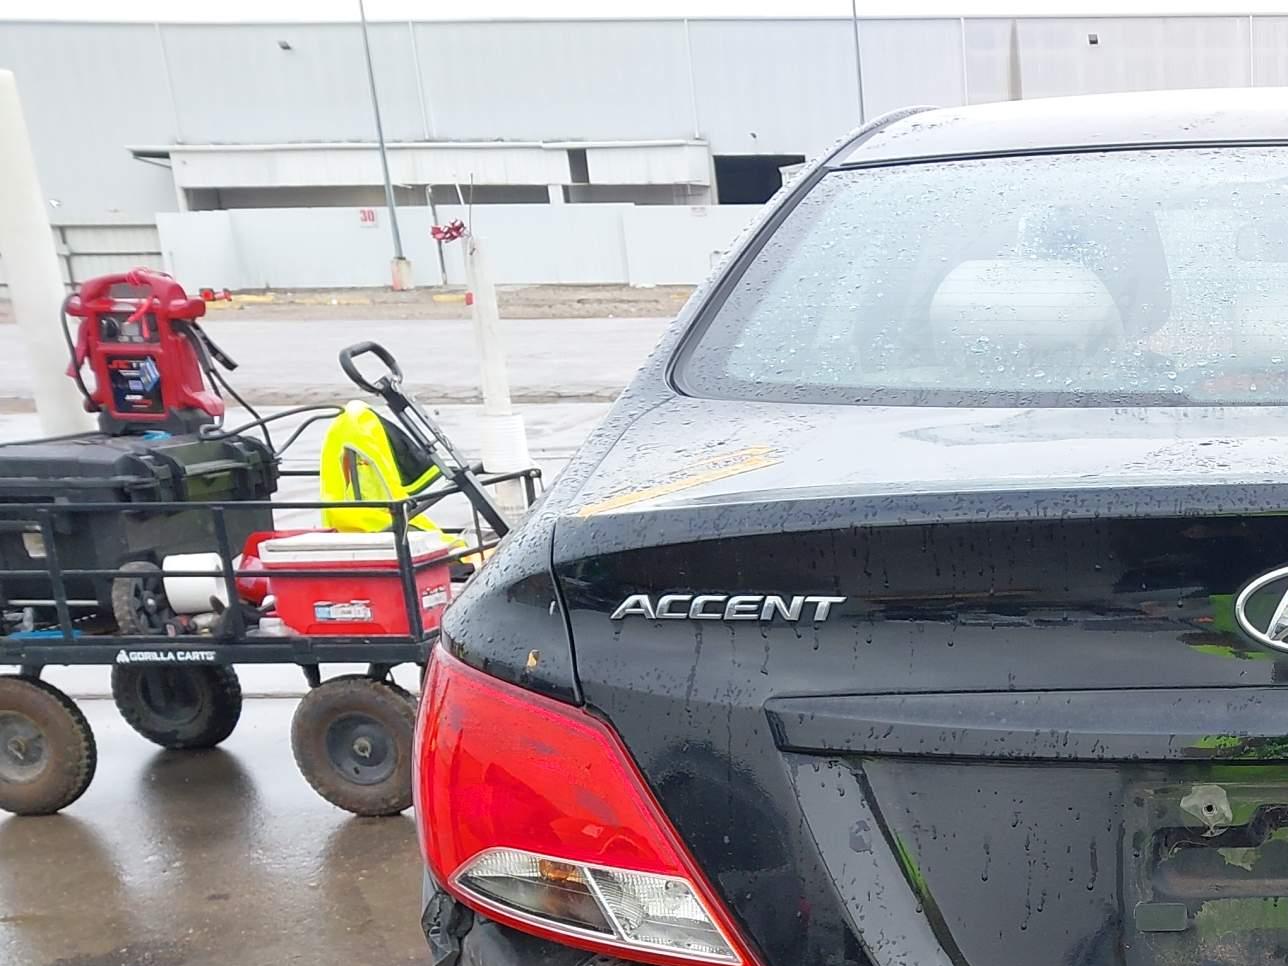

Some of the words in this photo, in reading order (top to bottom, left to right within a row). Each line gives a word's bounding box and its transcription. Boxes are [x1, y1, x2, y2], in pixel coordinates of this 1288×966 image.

[610, 594, 847, 621] ACCENT
[128, 651, 176, 661] GORILLA
[176, 651, 215, 661] CARTS
